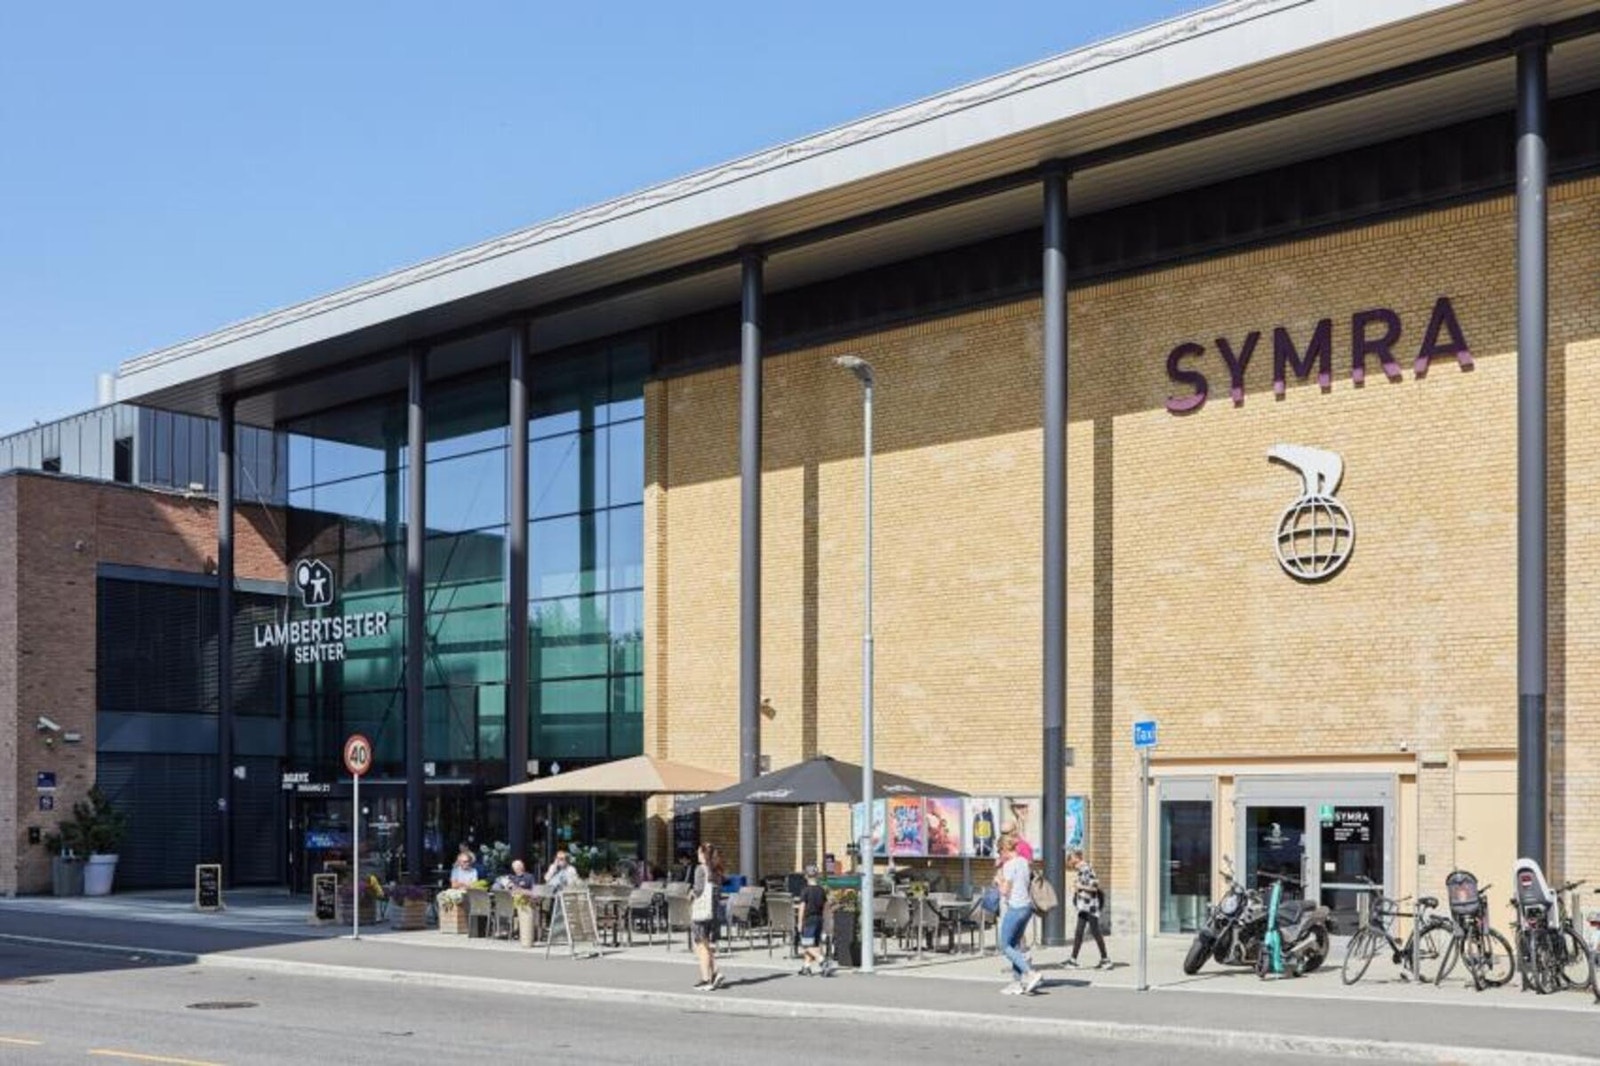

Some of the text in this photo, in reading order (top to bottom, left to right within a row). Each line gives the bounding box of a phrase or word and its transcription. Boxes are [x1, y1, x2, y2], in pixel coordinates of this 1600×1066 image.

[1166, 296, 1475, 413] SYMRA
[254, 611, 388, 648] LAMBERTSETER
[294, 642, 345, 664] SENTER
[349, 745, 368, 764] 40
[1335, 811, 1370, 821] SYMRA
